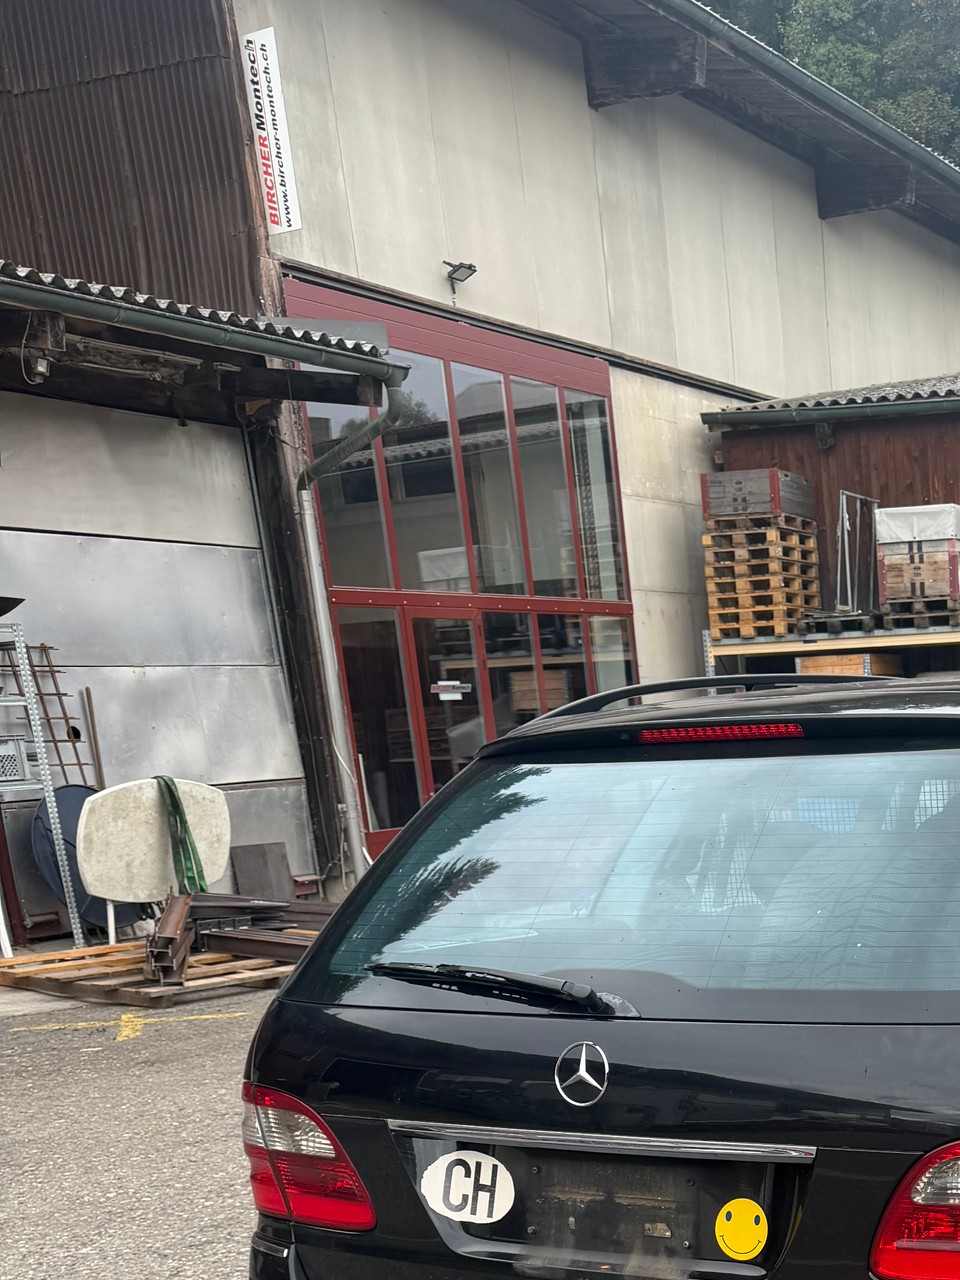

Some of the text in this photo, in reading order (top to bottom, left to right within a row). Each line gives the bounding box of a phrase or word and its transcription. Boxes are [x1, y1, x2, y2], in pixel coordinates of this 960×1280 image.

[244, 39, 280, 226] BIRCHER Montech
[442, 1157, 499, 1219] CH
